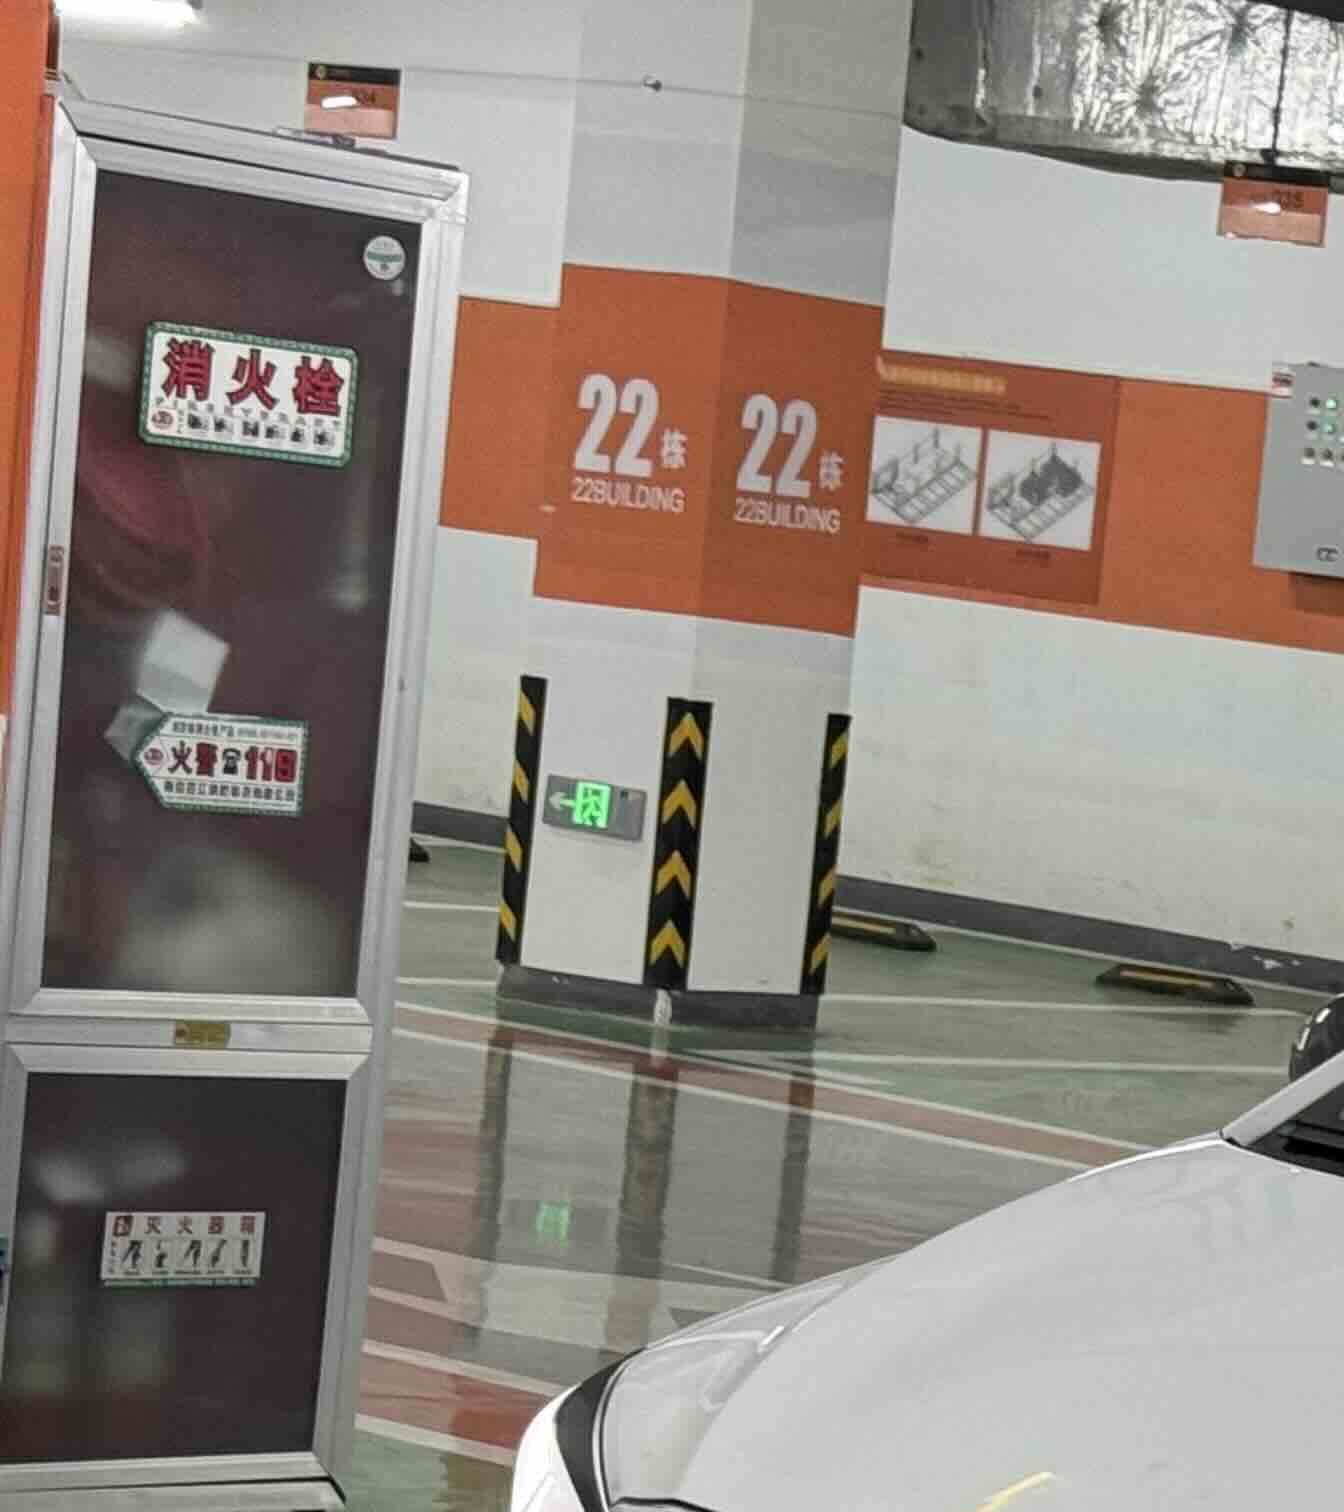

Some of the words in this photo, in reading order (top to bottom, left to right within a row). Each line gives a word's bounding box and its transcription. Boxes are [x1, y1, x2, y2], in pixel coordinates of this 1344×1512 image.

[162, 337, 345, 417] 消火栓
[571, 476, 685, 513] 22BUILDING
[244, 745, 299, 783] 119
